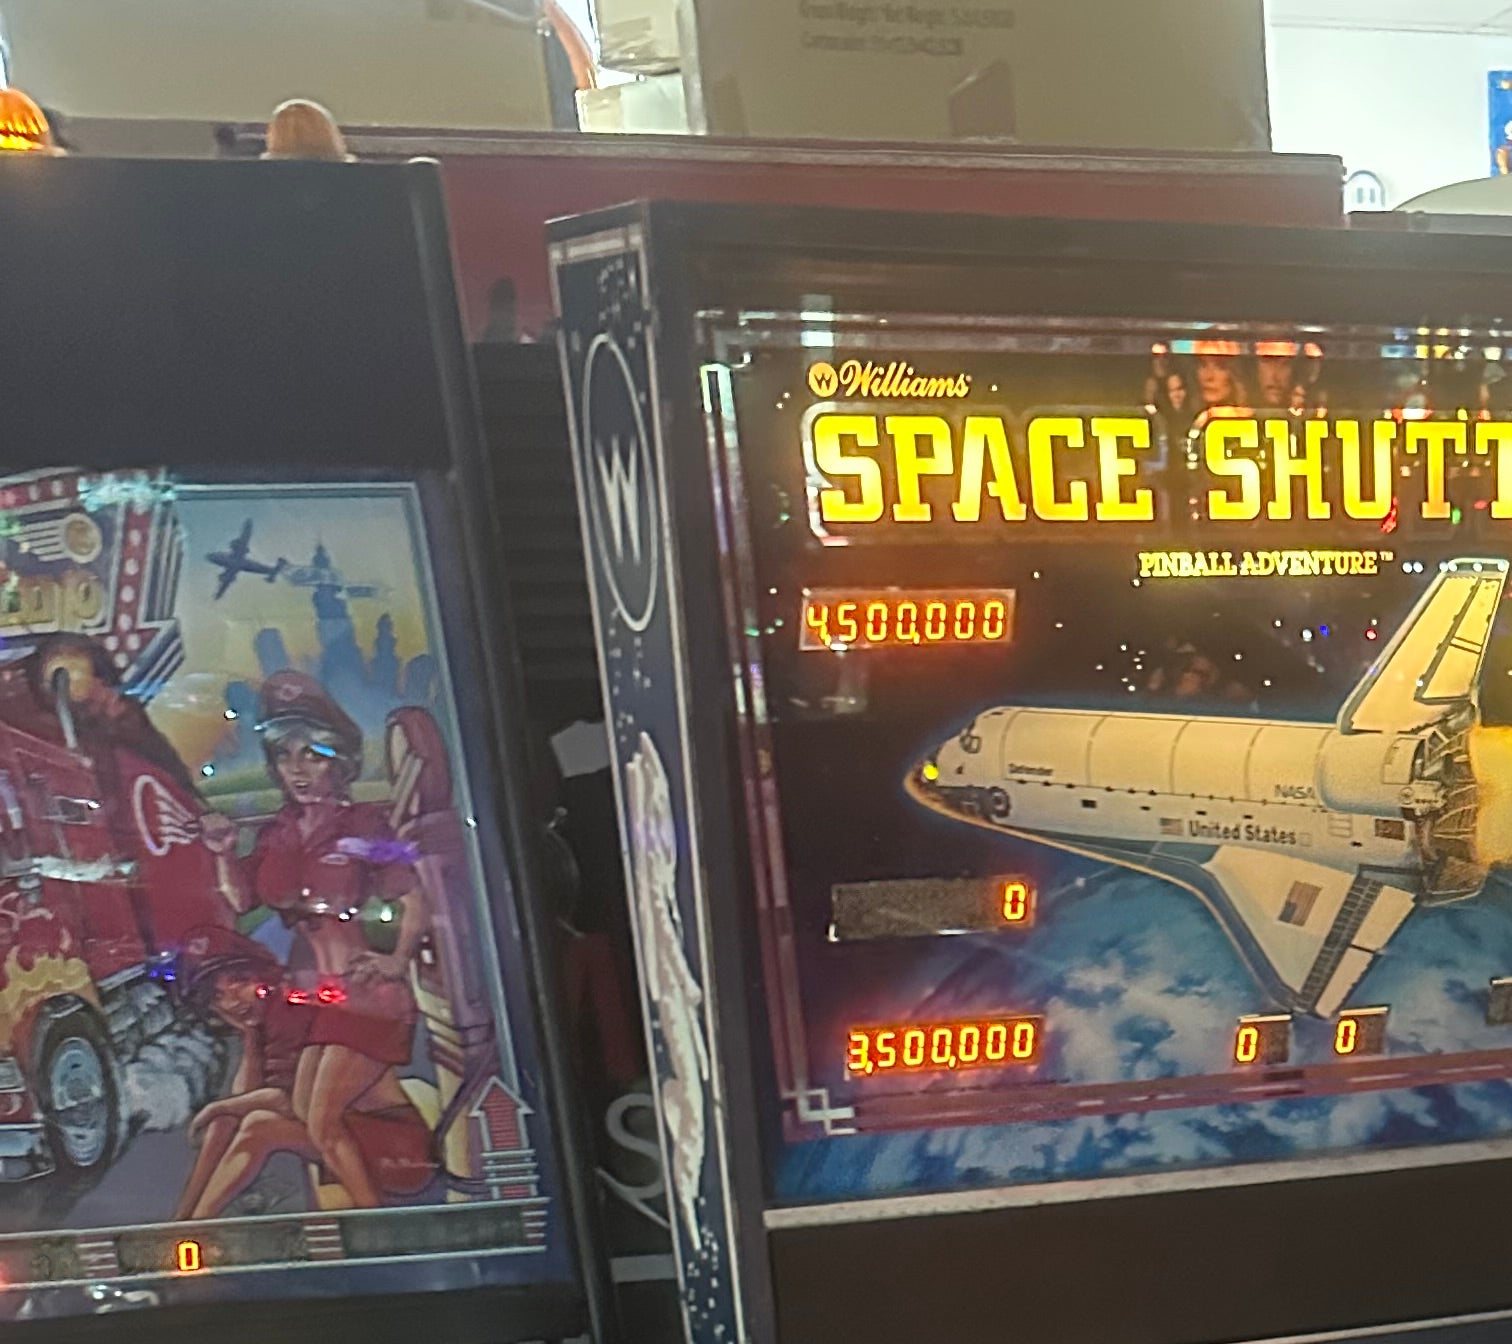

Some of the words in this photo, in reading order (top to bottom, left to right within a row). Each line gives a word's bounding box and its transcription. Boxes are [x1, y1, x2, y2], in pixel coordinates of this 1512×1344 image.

[839, 359, 974, 398] Williams
[813, 415, 1155, 523] SPACE
[1138, 551, 1237, 578] PINBALL
[805, 601, 1006, 645] 4,500,000
[1275, 784, 1317, 800] NASA
[1189, 820, 1240, 842] United
[1245, 824, 1297, 845] States
[1003, 881, 1028, 921] 0
[846, 1021, 1036, 1075] 3,500,000
